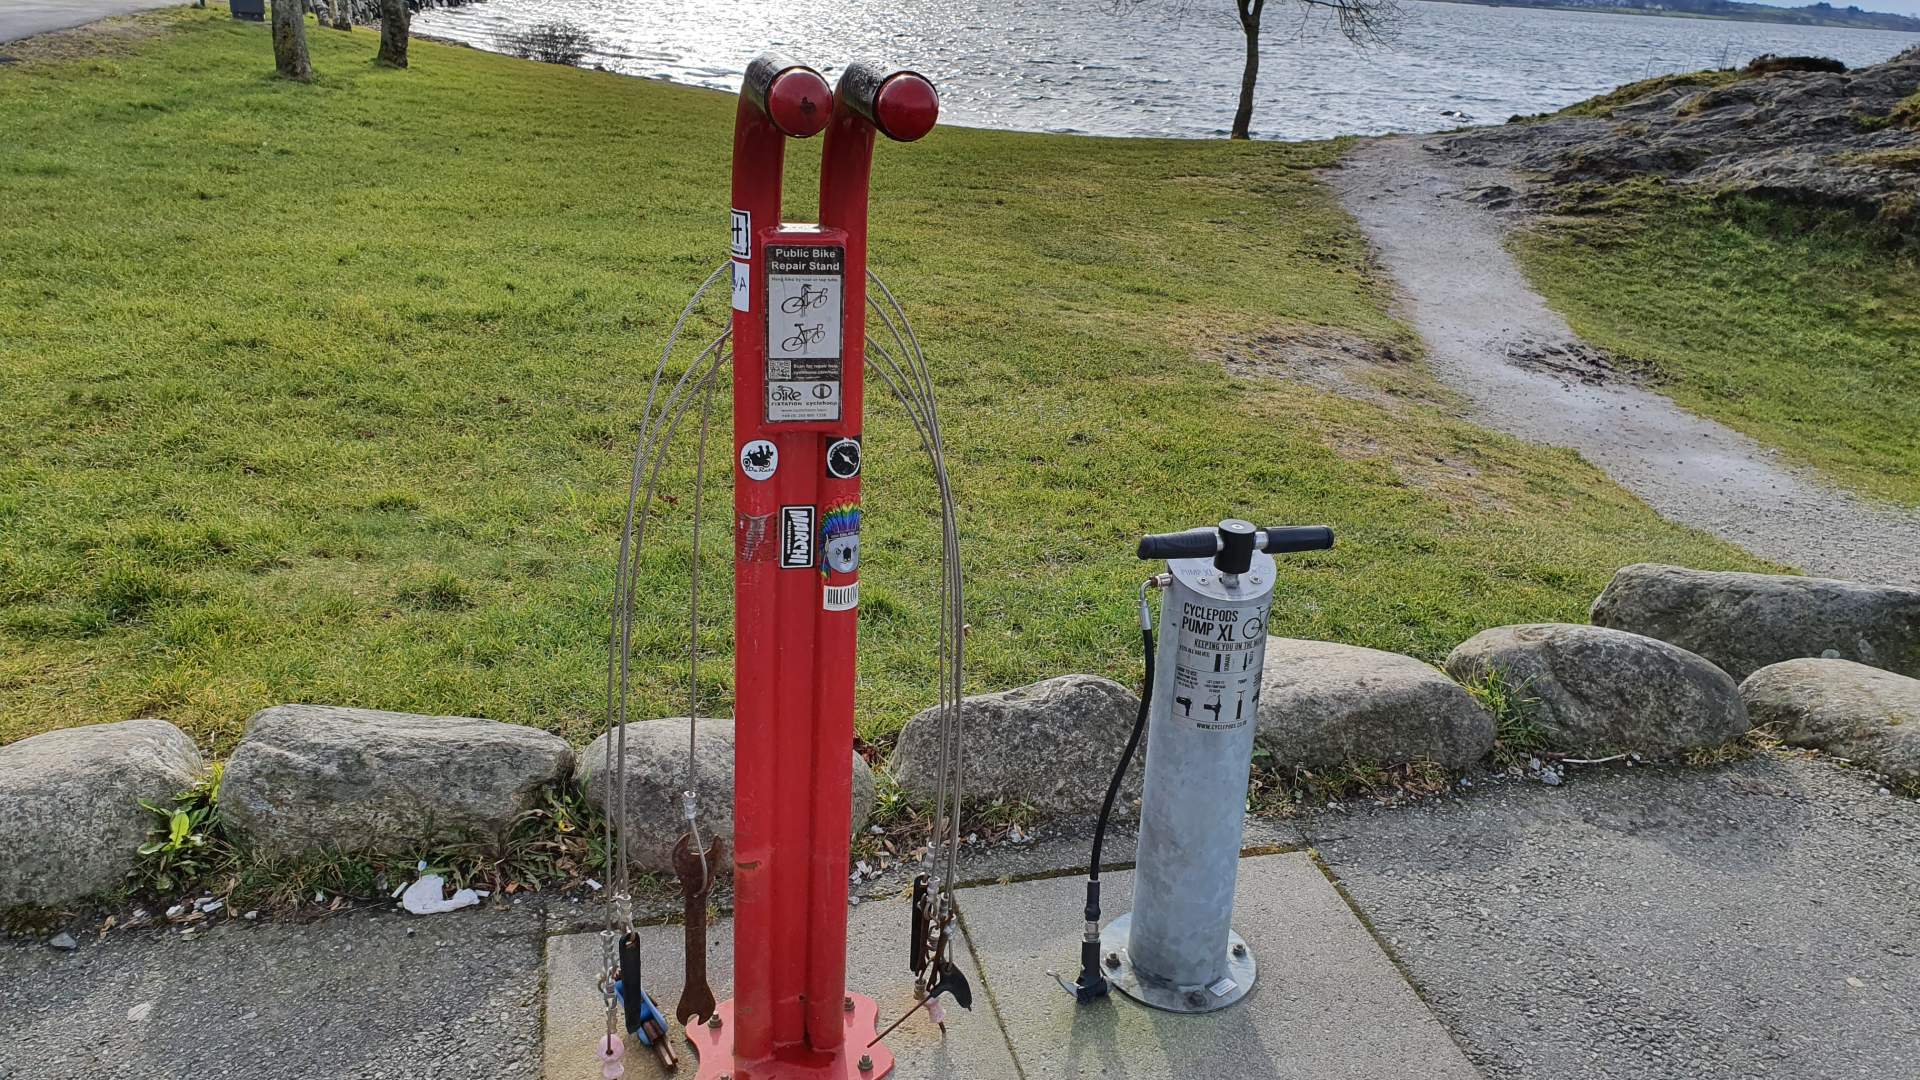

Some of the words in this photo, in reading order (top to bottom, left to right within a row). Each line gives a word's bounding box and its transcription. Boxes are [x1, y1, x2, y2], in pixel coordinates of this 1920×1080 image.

[775, 248, 809, 258] Public
[812, 249, 836, 258] Bike
[771, 261, 806, 272] Repair
[809, 261, 840, 271] Stand
[788, 510, 810, 565] MARCHI
[1183, 601, 1239, 623] CYCLEPODS
[1181, 615, 1214, 636] PUMP
[1216, 623, 1235, 642] XL
[1194, 638, 1220, 650] KEEPING
[1221, 642, 1234, 651] YOU
[1234, 642, 1243, 650] ON
